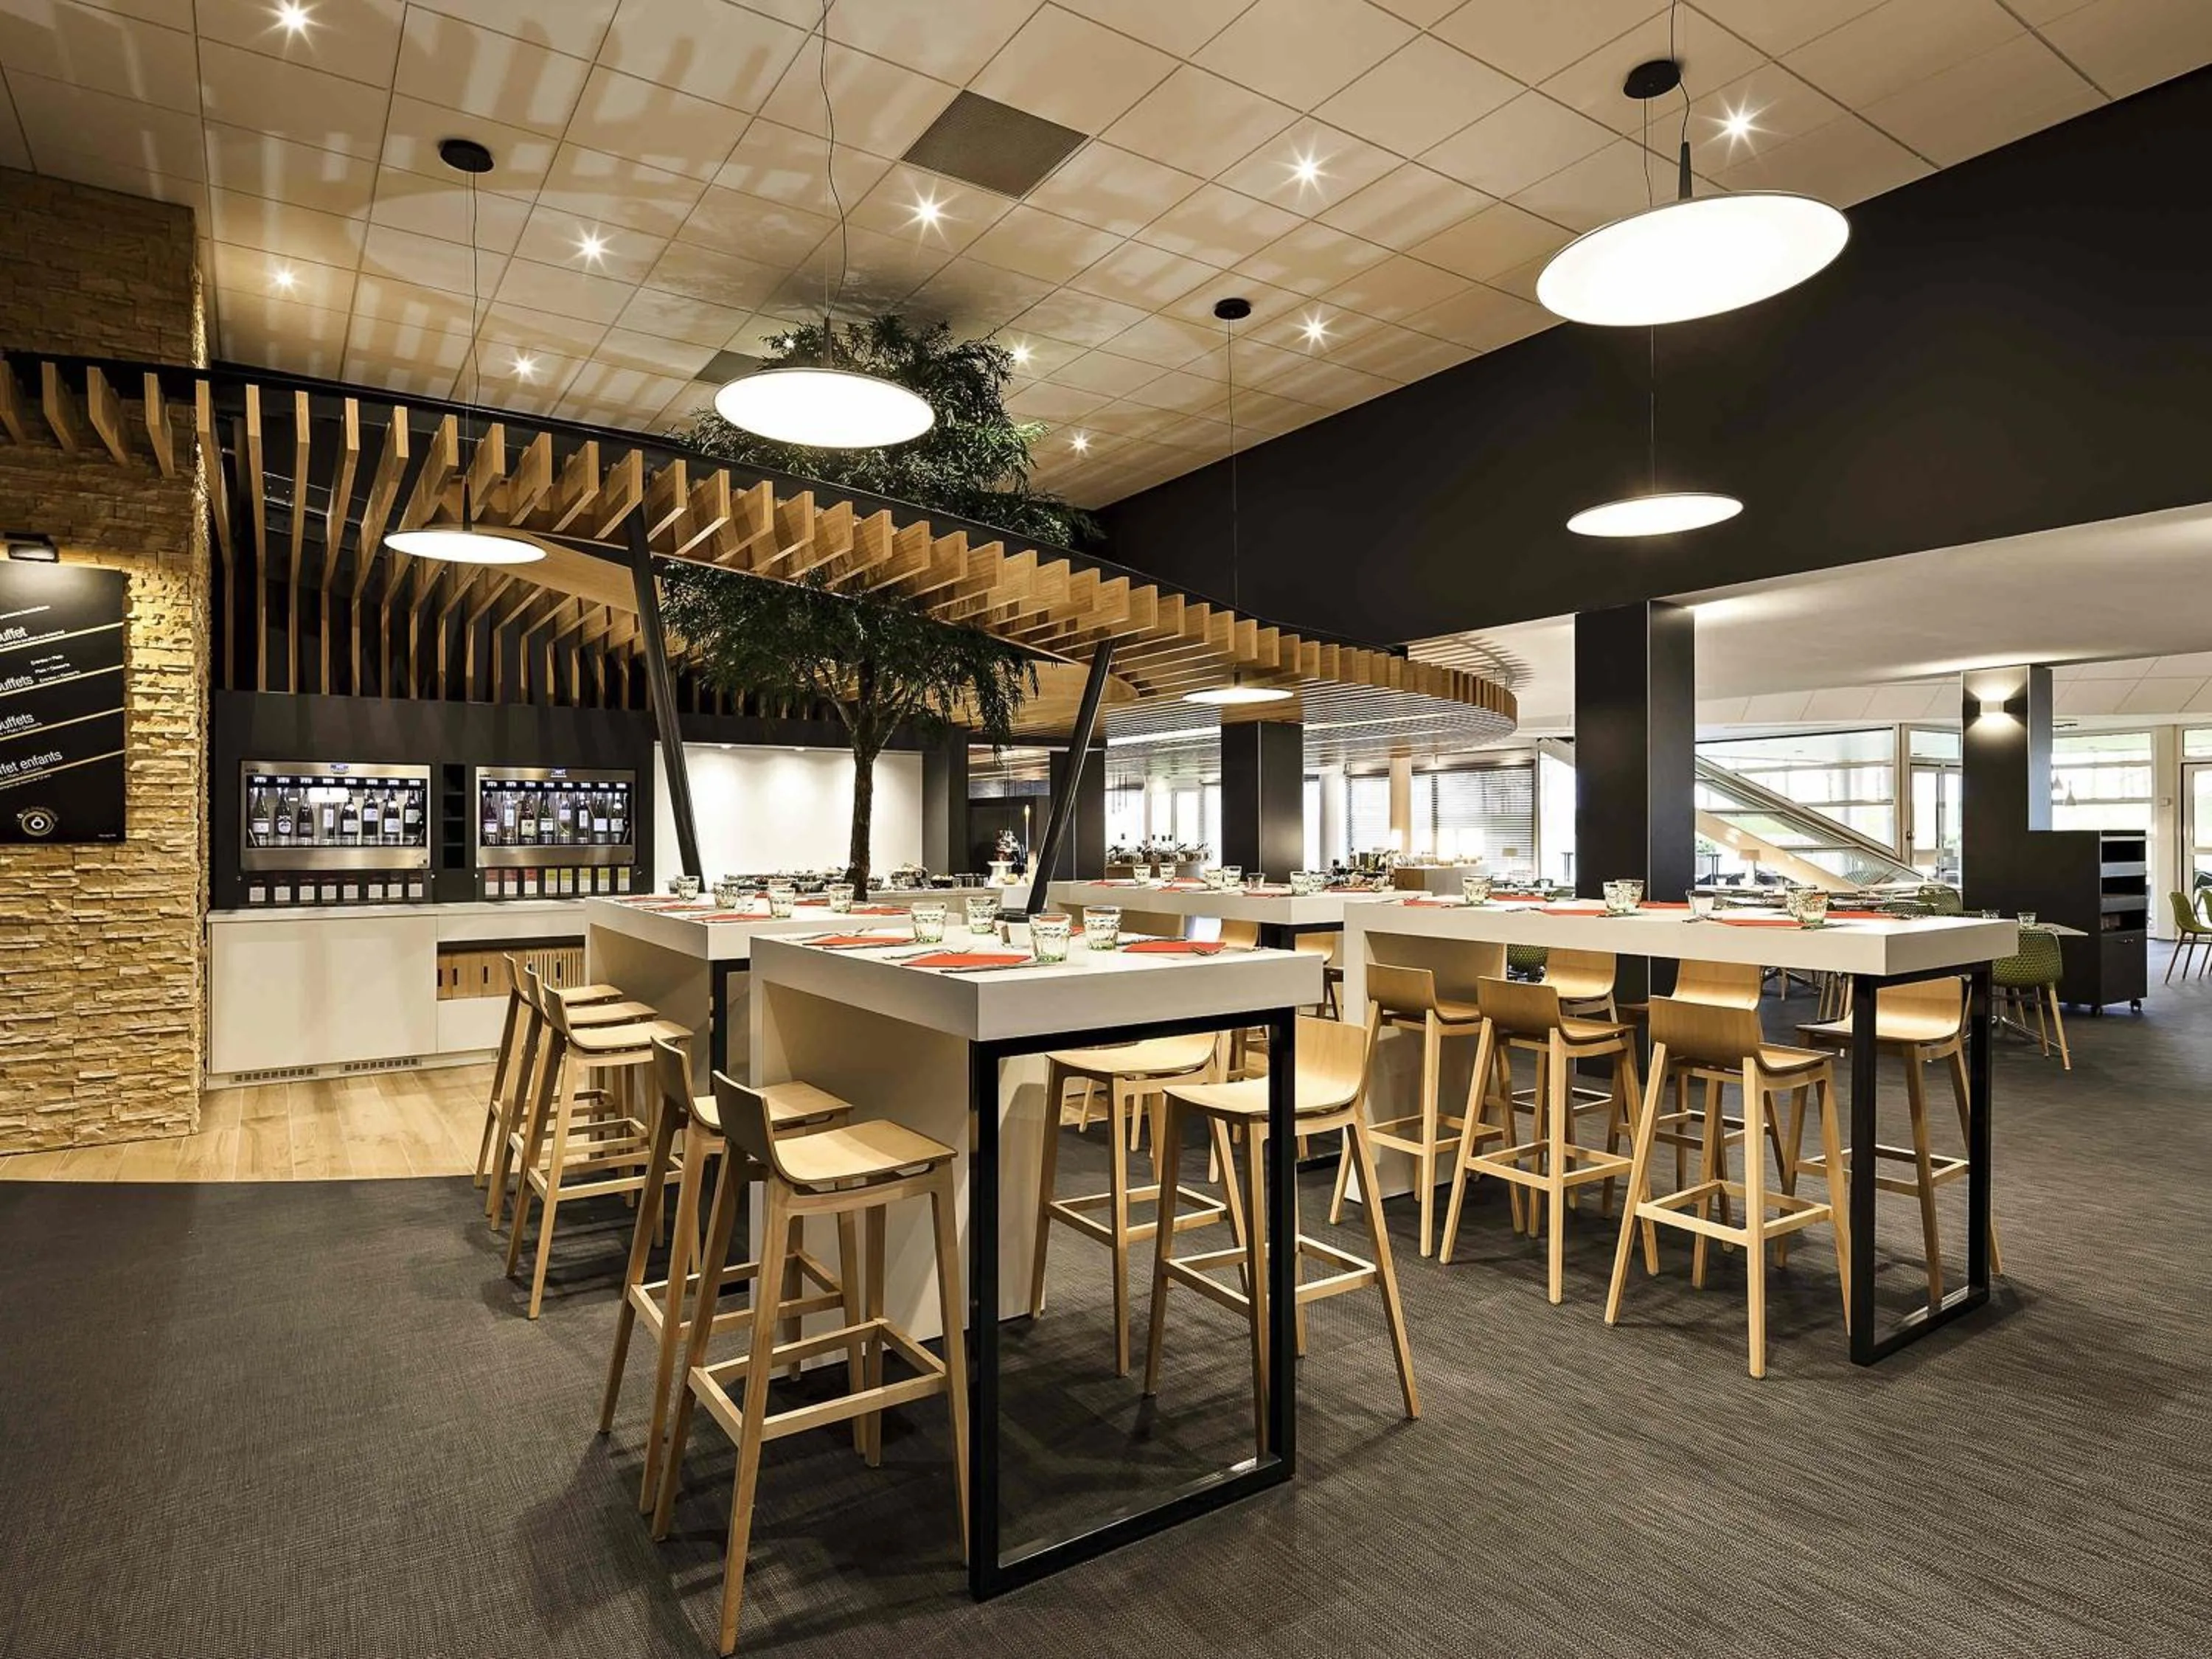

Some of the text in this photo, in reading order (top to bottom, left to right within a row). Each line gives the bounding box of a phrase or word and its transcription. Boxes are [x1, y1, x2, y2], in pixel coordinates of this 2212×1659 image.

[0, 675, 34, 692] uffets
[0, 714, 35, 731] uffets
[20, 751, 63, 769] enfants
